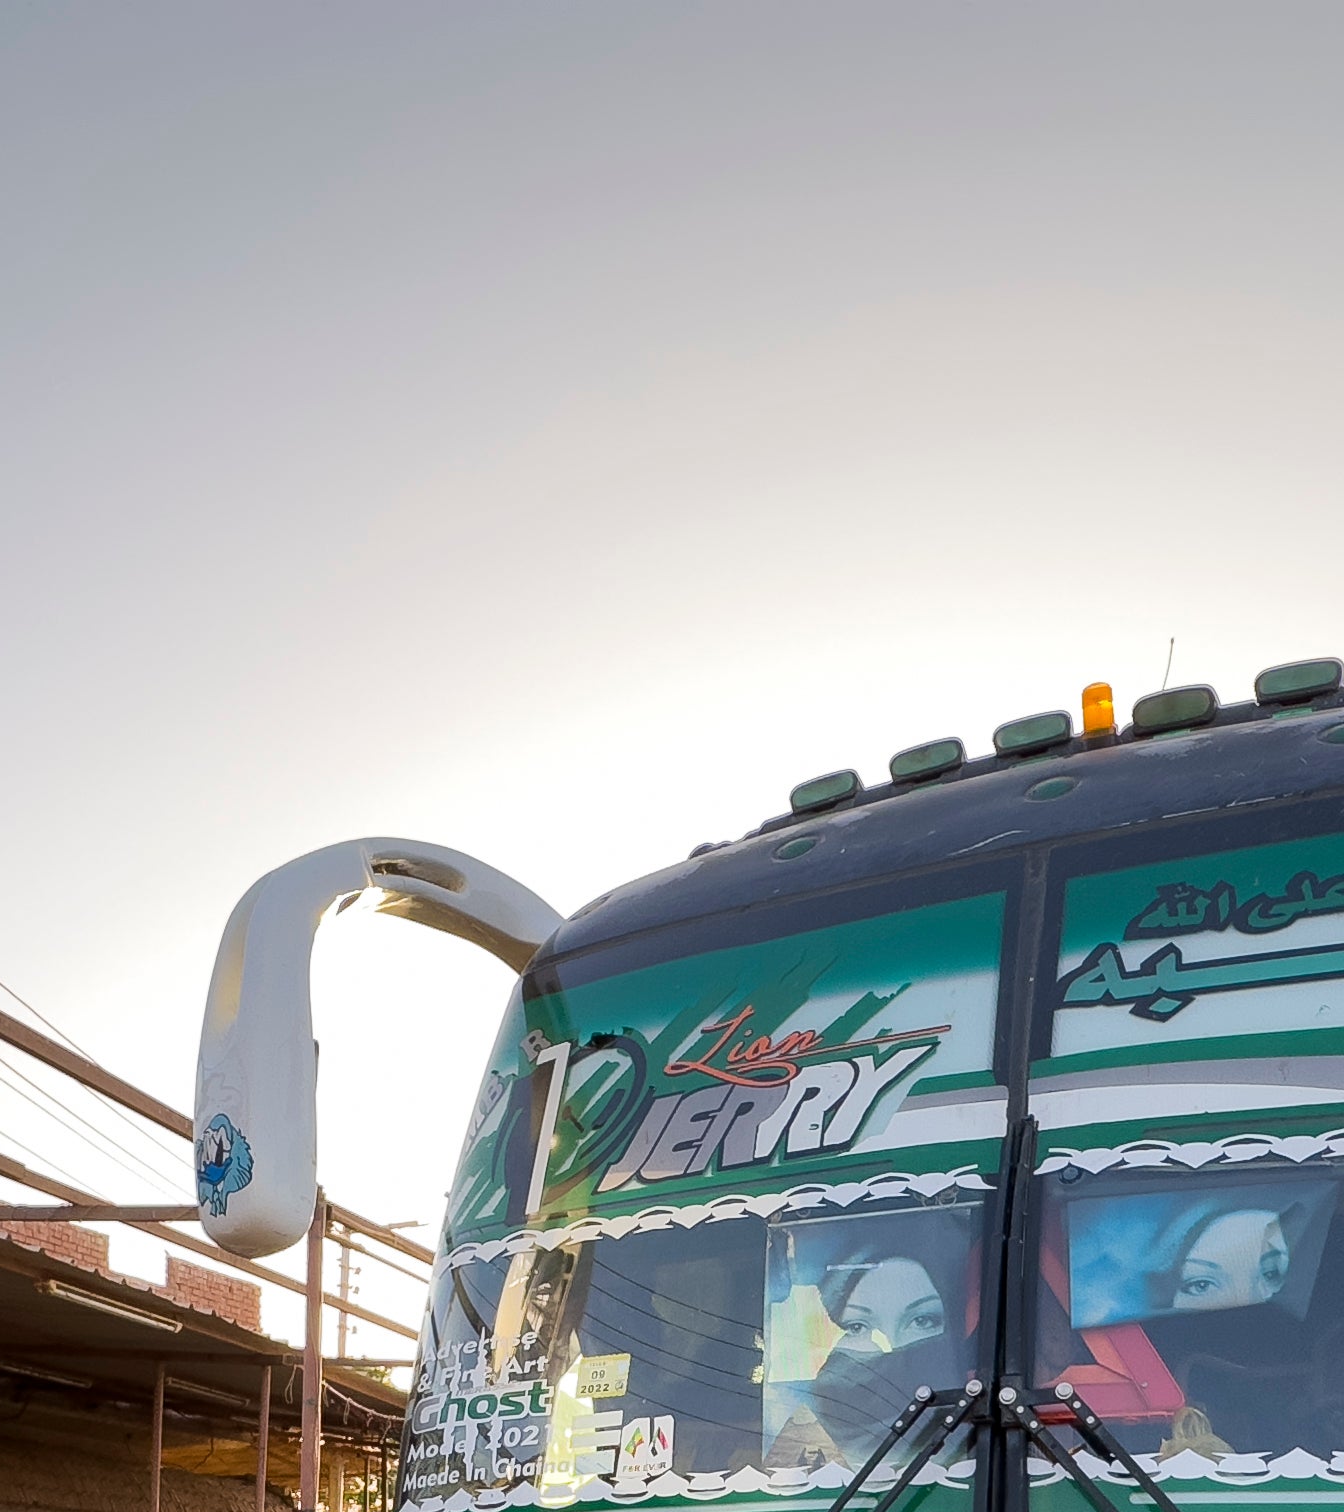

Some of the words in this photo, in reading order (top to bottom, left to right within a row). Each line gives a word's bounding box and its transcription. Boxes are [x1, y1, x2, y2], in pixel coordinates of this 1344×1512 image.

[1136, 882, 1234, 936] الله
[663, 1005, 881, 1087] Lion
[596, 1043, 938, 1193] JERRY
[413, 1381, 553, 1432] Ghost
[417, 1375, 432, 1393] &
[580, 1383, 610, 1394] 2022
